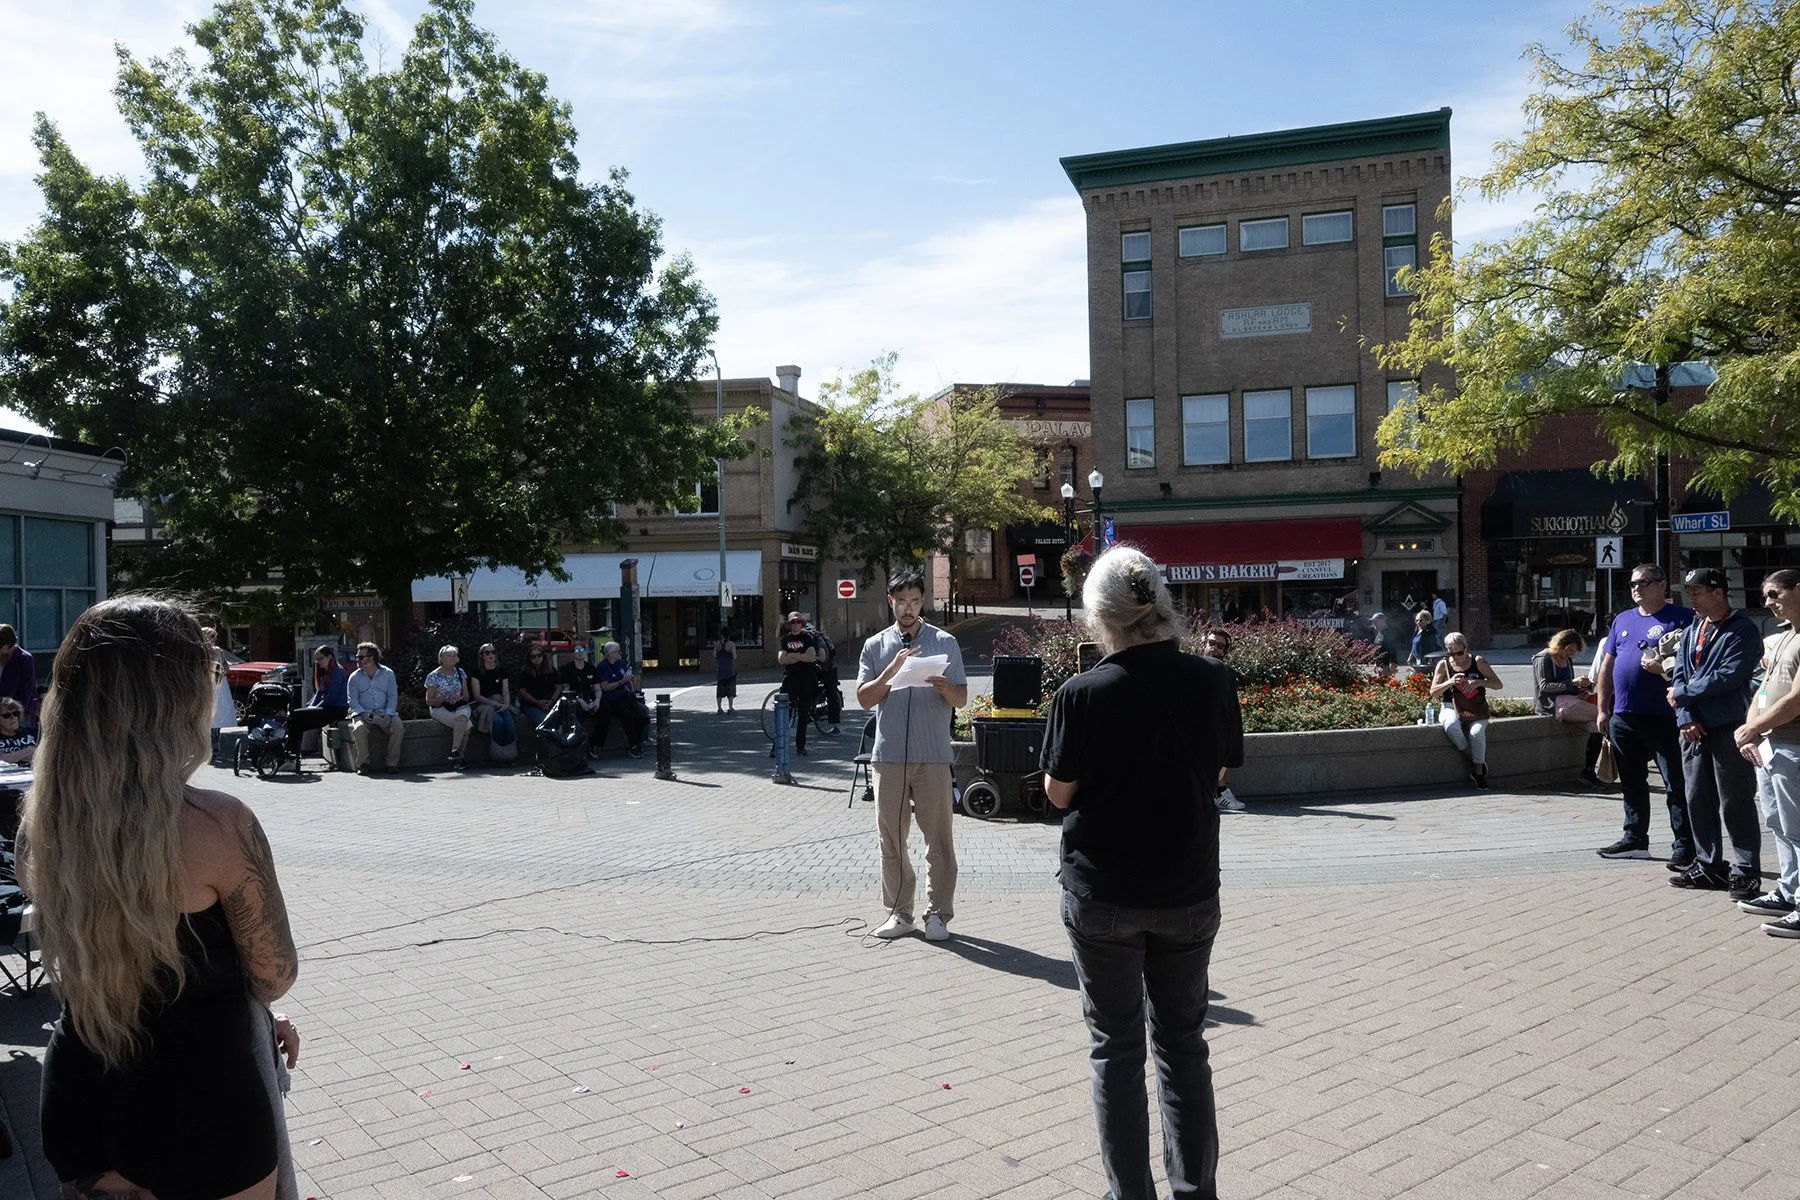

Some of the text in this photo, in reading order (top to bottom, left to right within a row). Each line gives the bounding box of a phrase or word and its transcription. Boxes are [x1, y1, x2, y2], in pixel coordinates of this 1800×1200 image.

[1228, 307, 1303, 320] ASHLAR LODGE
[1026, 421, 1091, 436] PALAC
[1530, 515, 1606, 531] SUKKHOTHAI
[1674, 514, 1727, 530] Wharf St.
[1170, 563, 1278, 581] RED'S BAKERY
[354, 598, 384, 608] REVIVA
